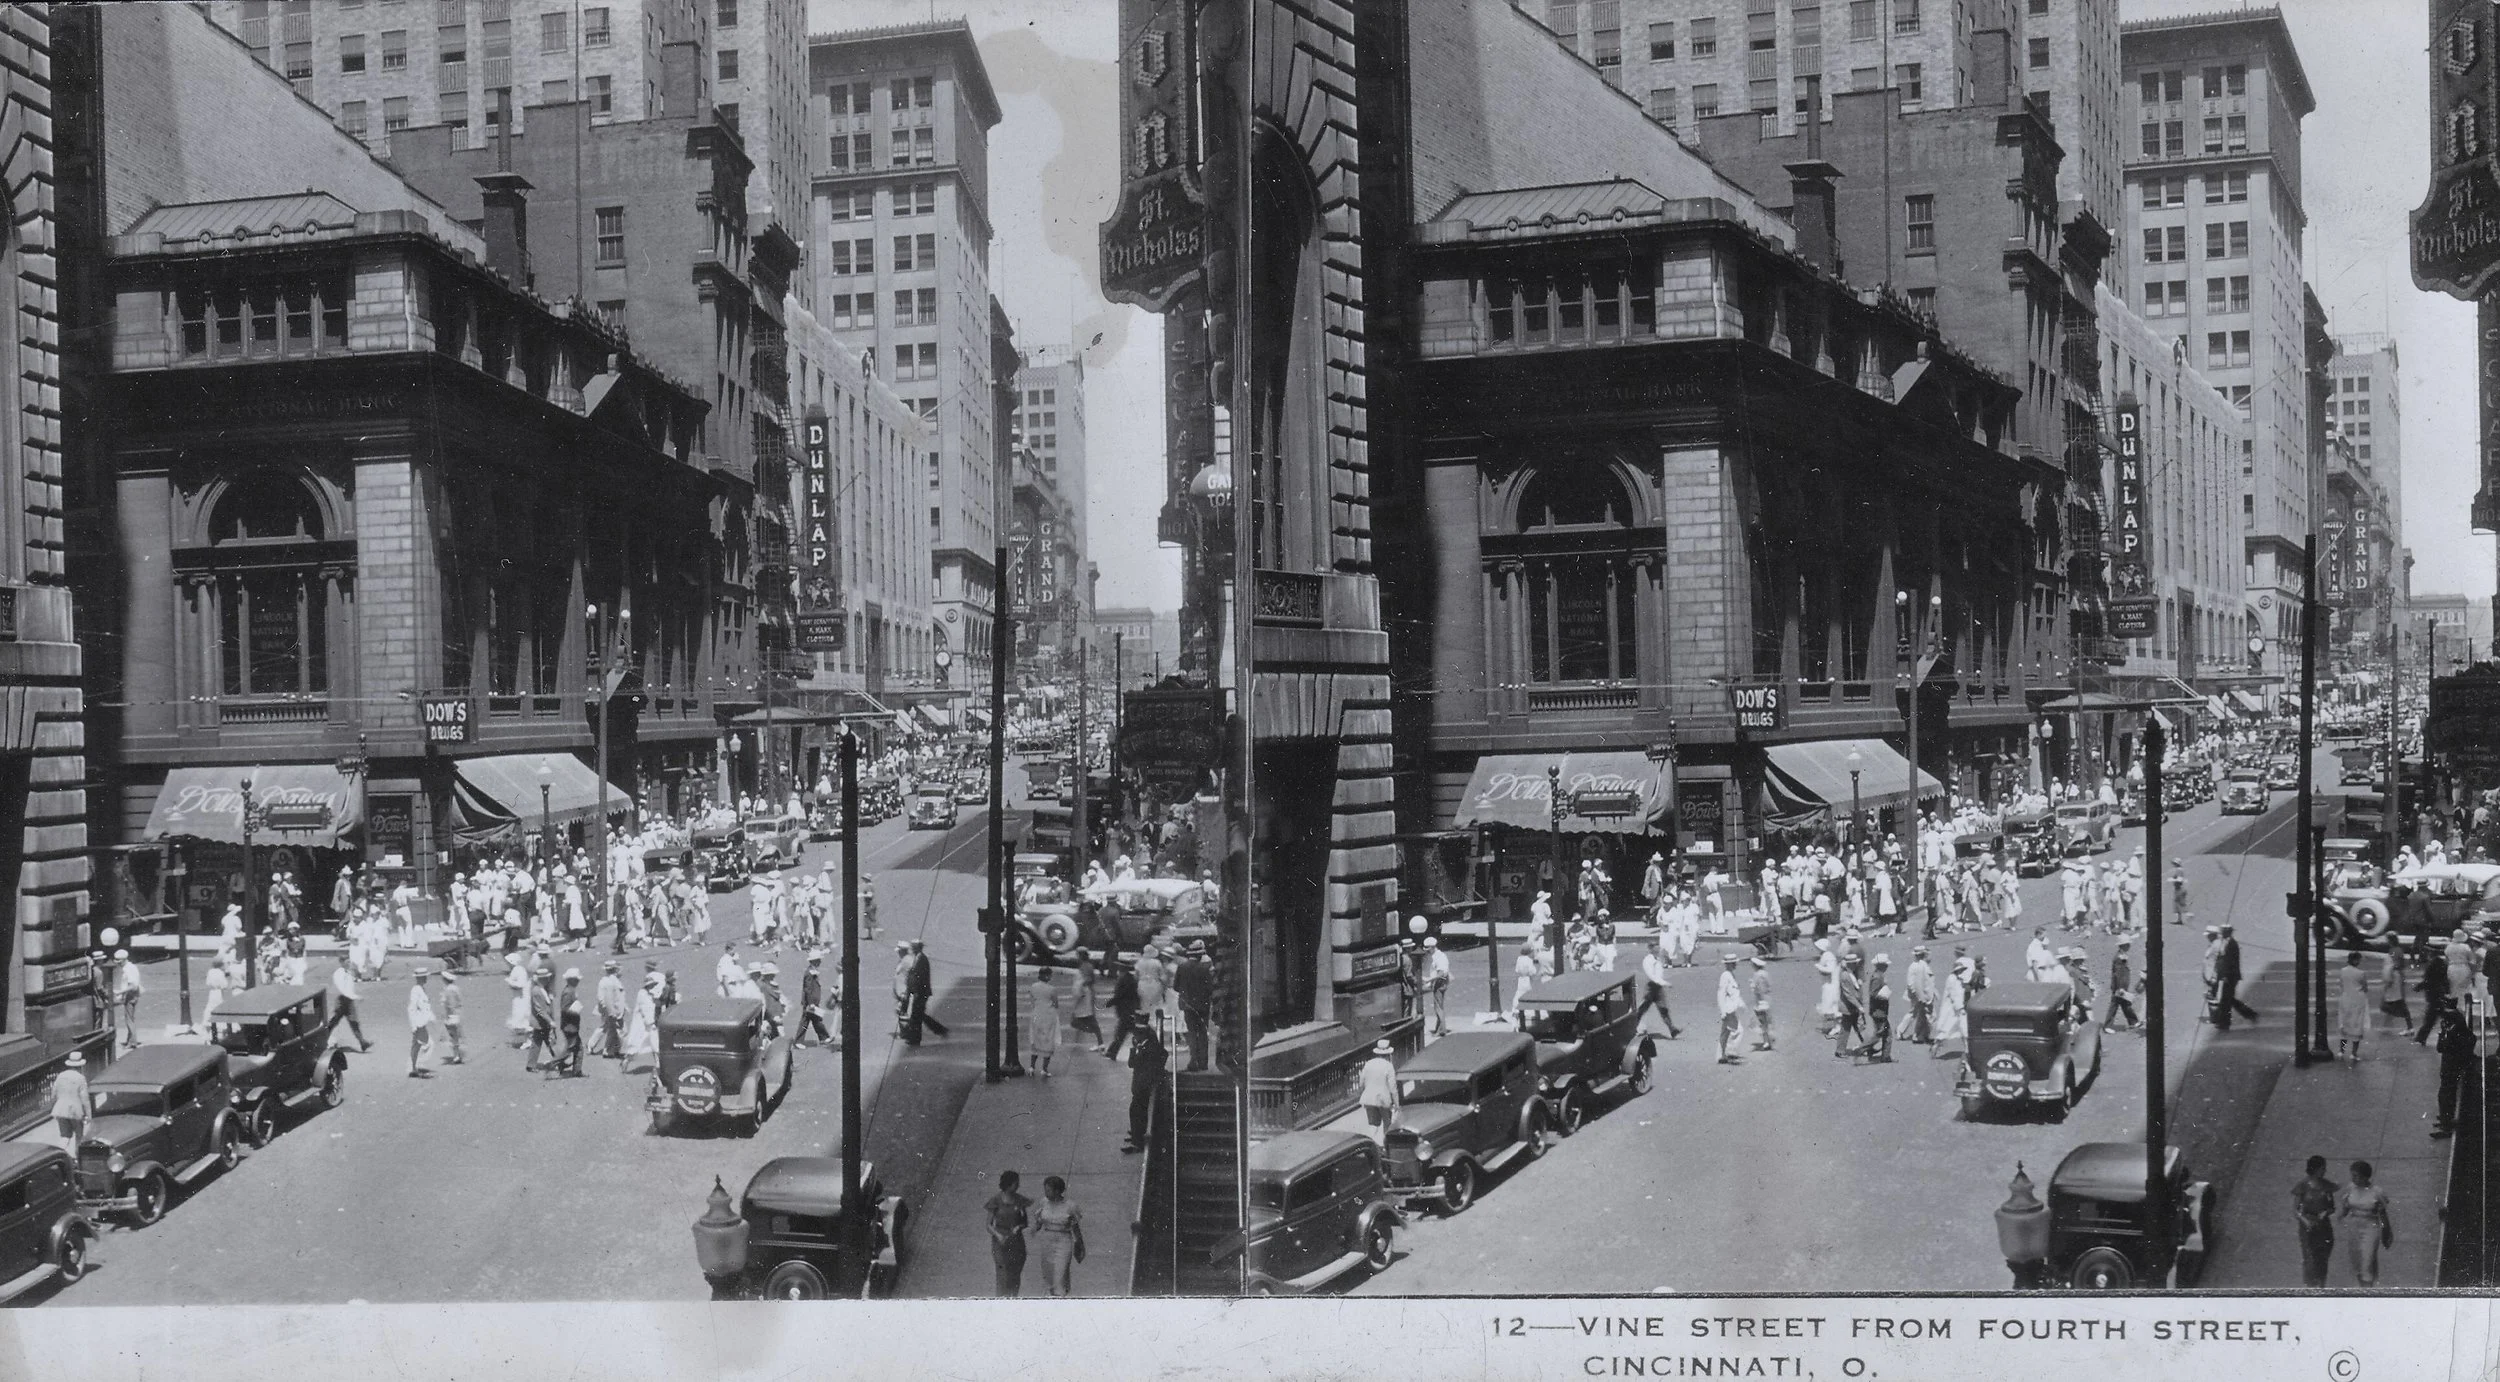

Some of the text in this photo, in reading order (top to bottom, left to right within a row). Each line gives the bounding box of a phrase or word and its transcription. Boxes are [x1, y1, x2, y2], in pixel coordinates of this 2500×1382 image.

[1105, 224, 1200, 273] Nicholas
[2418, 210, 2500, 263] Nichola
[808, 425, 828, 567] DUNLAP
[2120, 412, 2139, 553] DUNLAP
[1041, 521, 1054, 603] GRAND
[2355, 508, 2369, 590] GRAND
[426, 701, 468, 722] DOW'S
[1736, 687, 1777, 709] DOW'S
[431, 725, 465, 740] DRUGS
[1741, 711, 1775, 727] DRUGS
[371, 814, 411, 832] Dow's
[1682, 801, 1721, 820] Dow's
